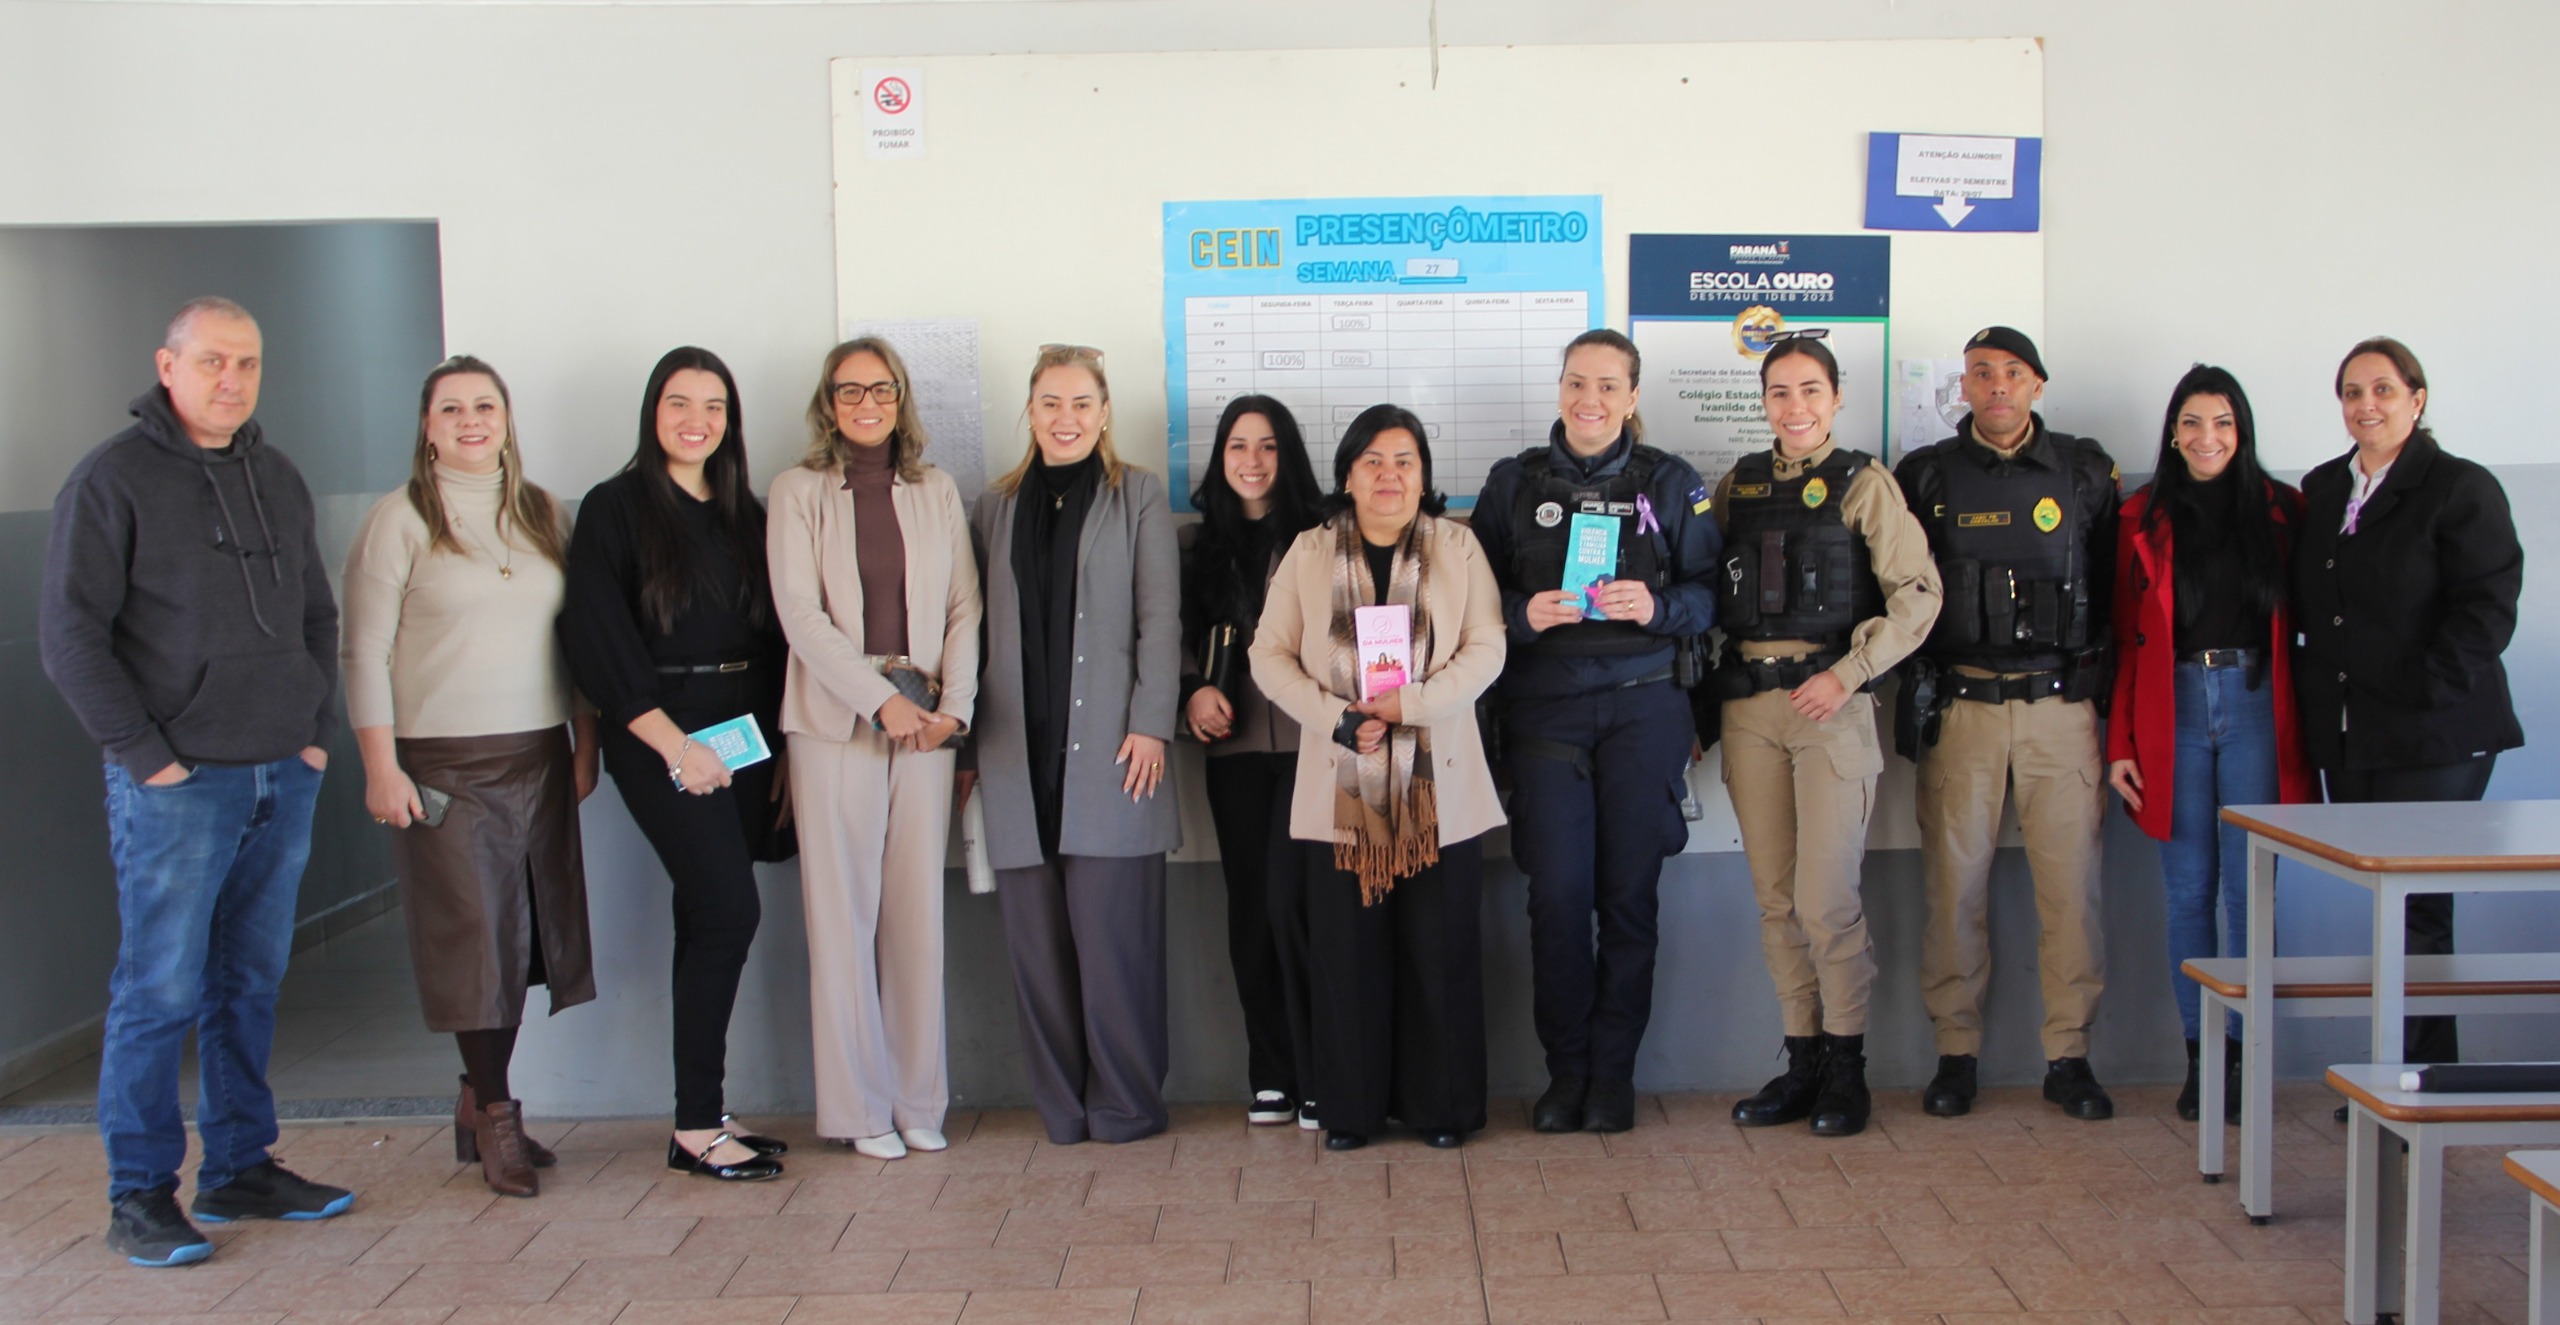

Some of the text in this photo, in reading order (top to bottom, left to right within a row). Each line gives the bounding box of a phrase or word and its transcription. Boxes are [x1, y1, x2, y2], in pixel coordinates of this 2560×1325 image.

[872, 128, 915, 137] PROIBIDO
[878, 141, 910, 149] FUMAR
[1918, 150, 1960, 160] ATENÇÃO
[1910, 175, 1951, 184] ELETIVAS
[1963, 177, 2007, 186] SEMESTRE
[1933, 189, 1958, 198] DATA:
[1296, 206, 1588, 251] PRESENÇÔMETRO
[1190, 229, 1283, 269] CEIN
[1730, 243, 1777, 256] PARANÁ
[1297, 260, 1440, 283] SEMANA 27
[1690, 272, 1834, 290] ESCOLA OURO
[1690, 291, 1834, 302] DESTAQUE IDEB 2023
[1339, 319, 1365, 329] 100%
[1267, 354, 1302, 367] 100%
[1338, 355, 1365, 365] 100%
[1678, 368, 1716, 376] Secretaria
[1718, 368, 1728, 376] de
[1730, 368, 1757, 376] Estado
[1678, 389, 1764, 401] Colégio Estadu
[1701, 402, 1763, 412] Ivanilde de
[1338, 410, 1357, 420] 100
[1694, 415, 1769, 423] Ensino Fundame
[1737, 427, 1773, 435] Arapong
[1581, 527, 1607, 536] VIOLÊNCIA
[1578, 547, 1601, 555] CONTRA
[1577, 555, 1606, 566] MULHER
